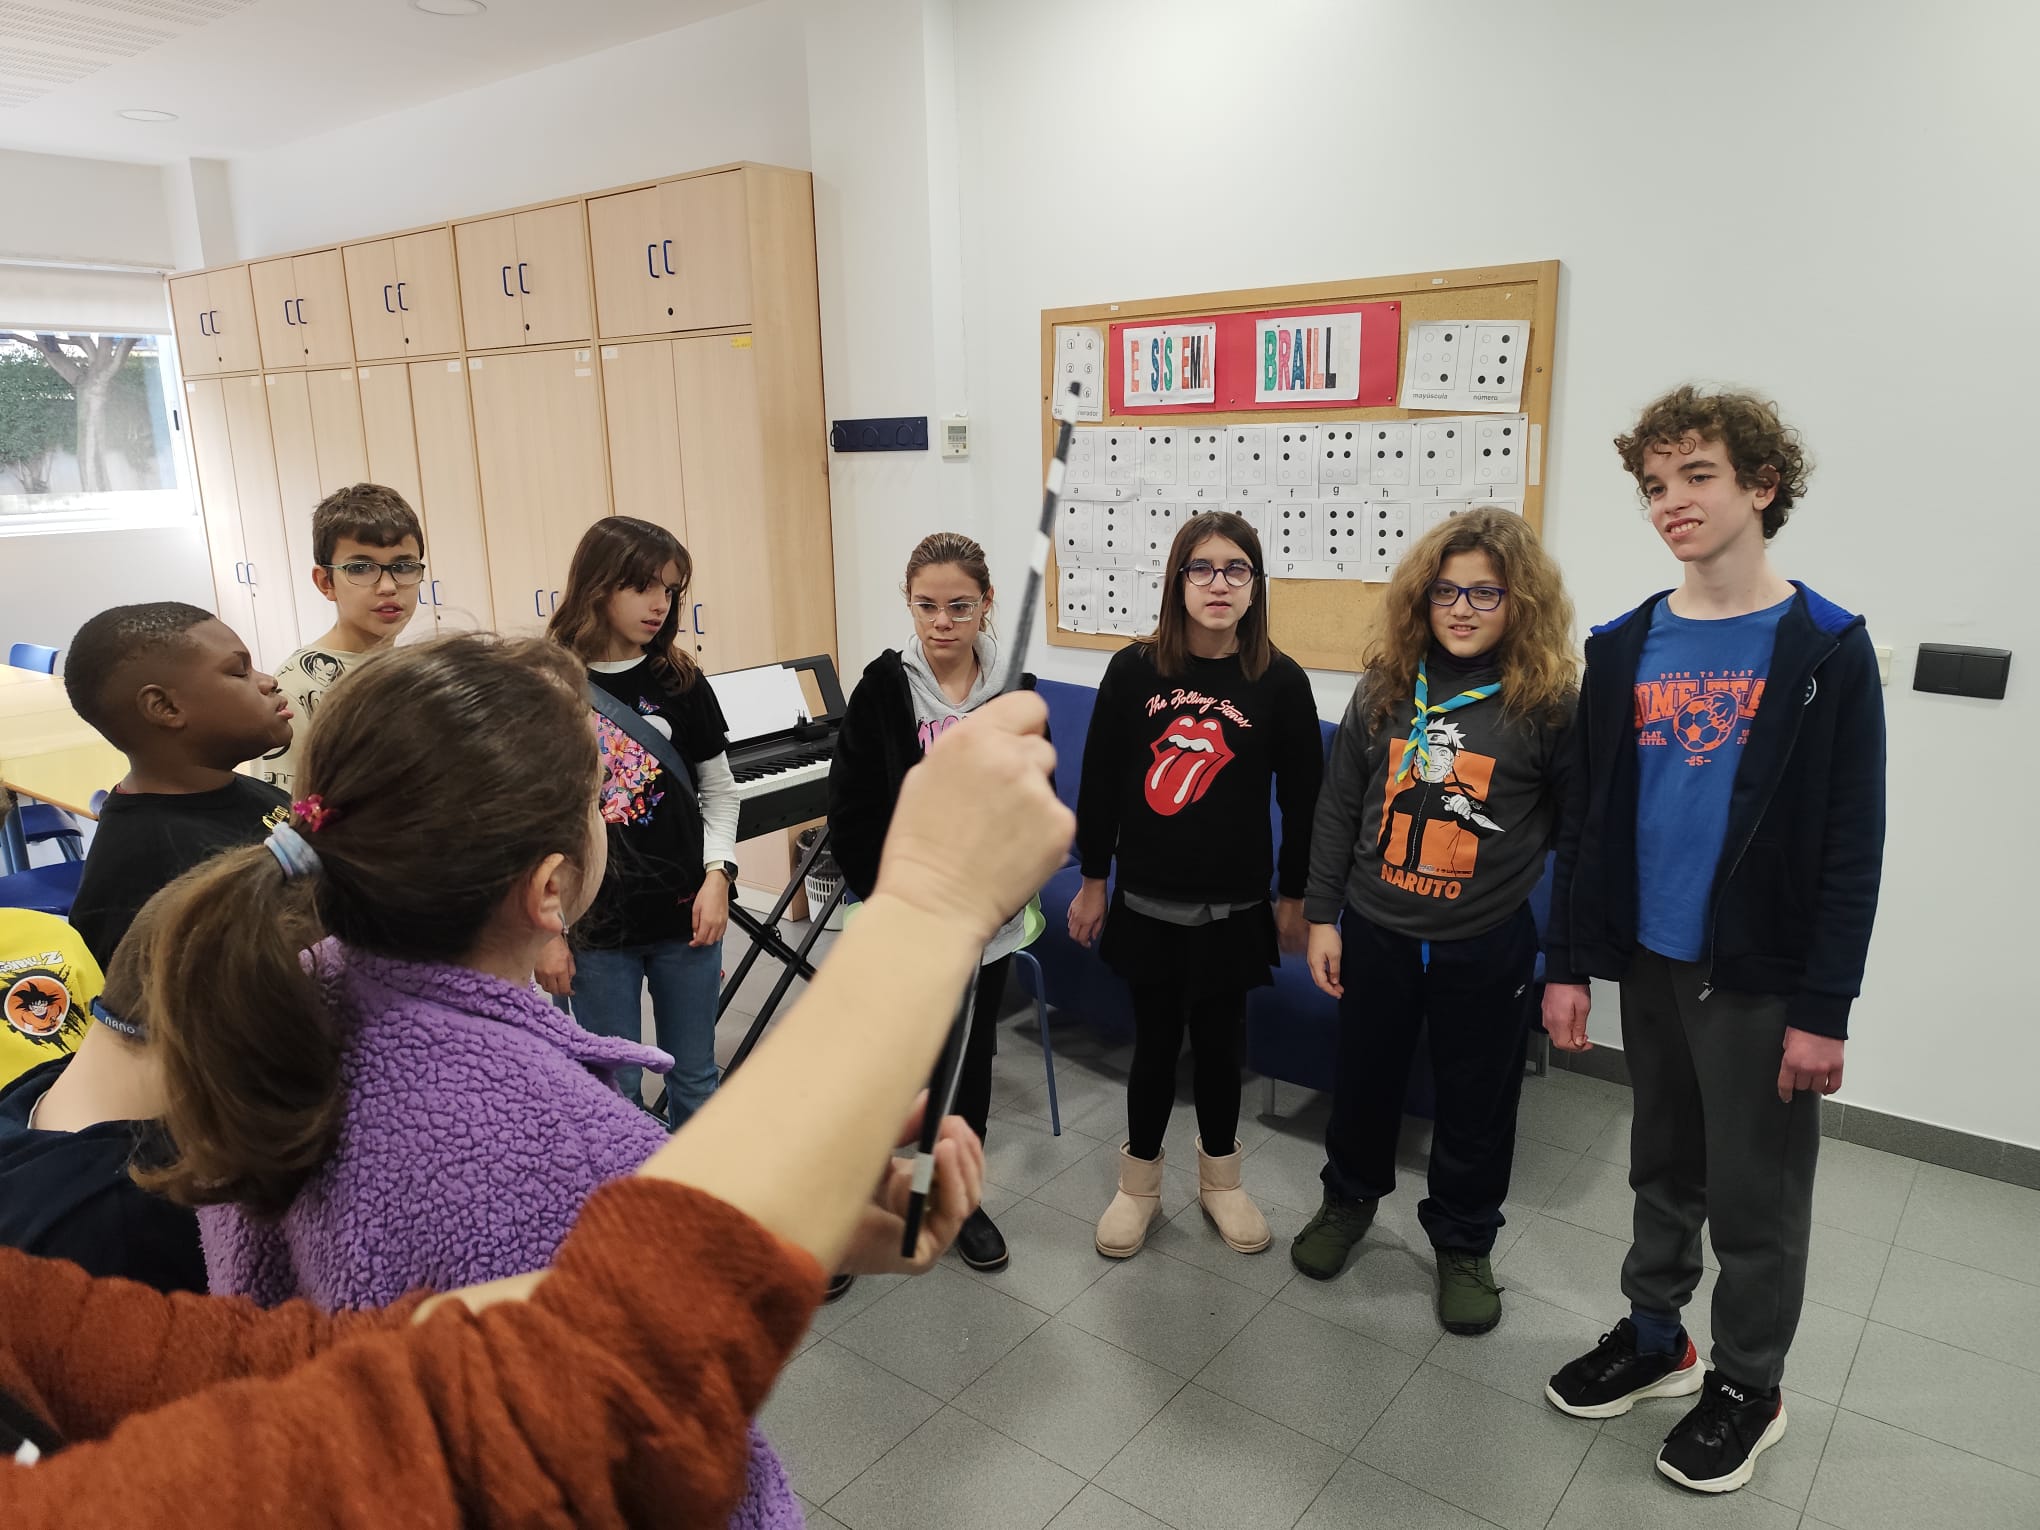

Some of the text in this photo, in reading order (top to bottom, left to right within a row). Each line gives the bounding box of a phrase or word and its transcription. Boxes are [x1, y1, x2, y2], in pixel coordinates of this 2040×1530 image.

[1723, 669, 1754, 677] PLAY
[1145, 688, 1252, 727] The Rolling Stones
[1381, 864, 1462, 899] NARUTO
[40, 951, 64, 965] Z
[1721, 1385, 1743, 1401] FILA
